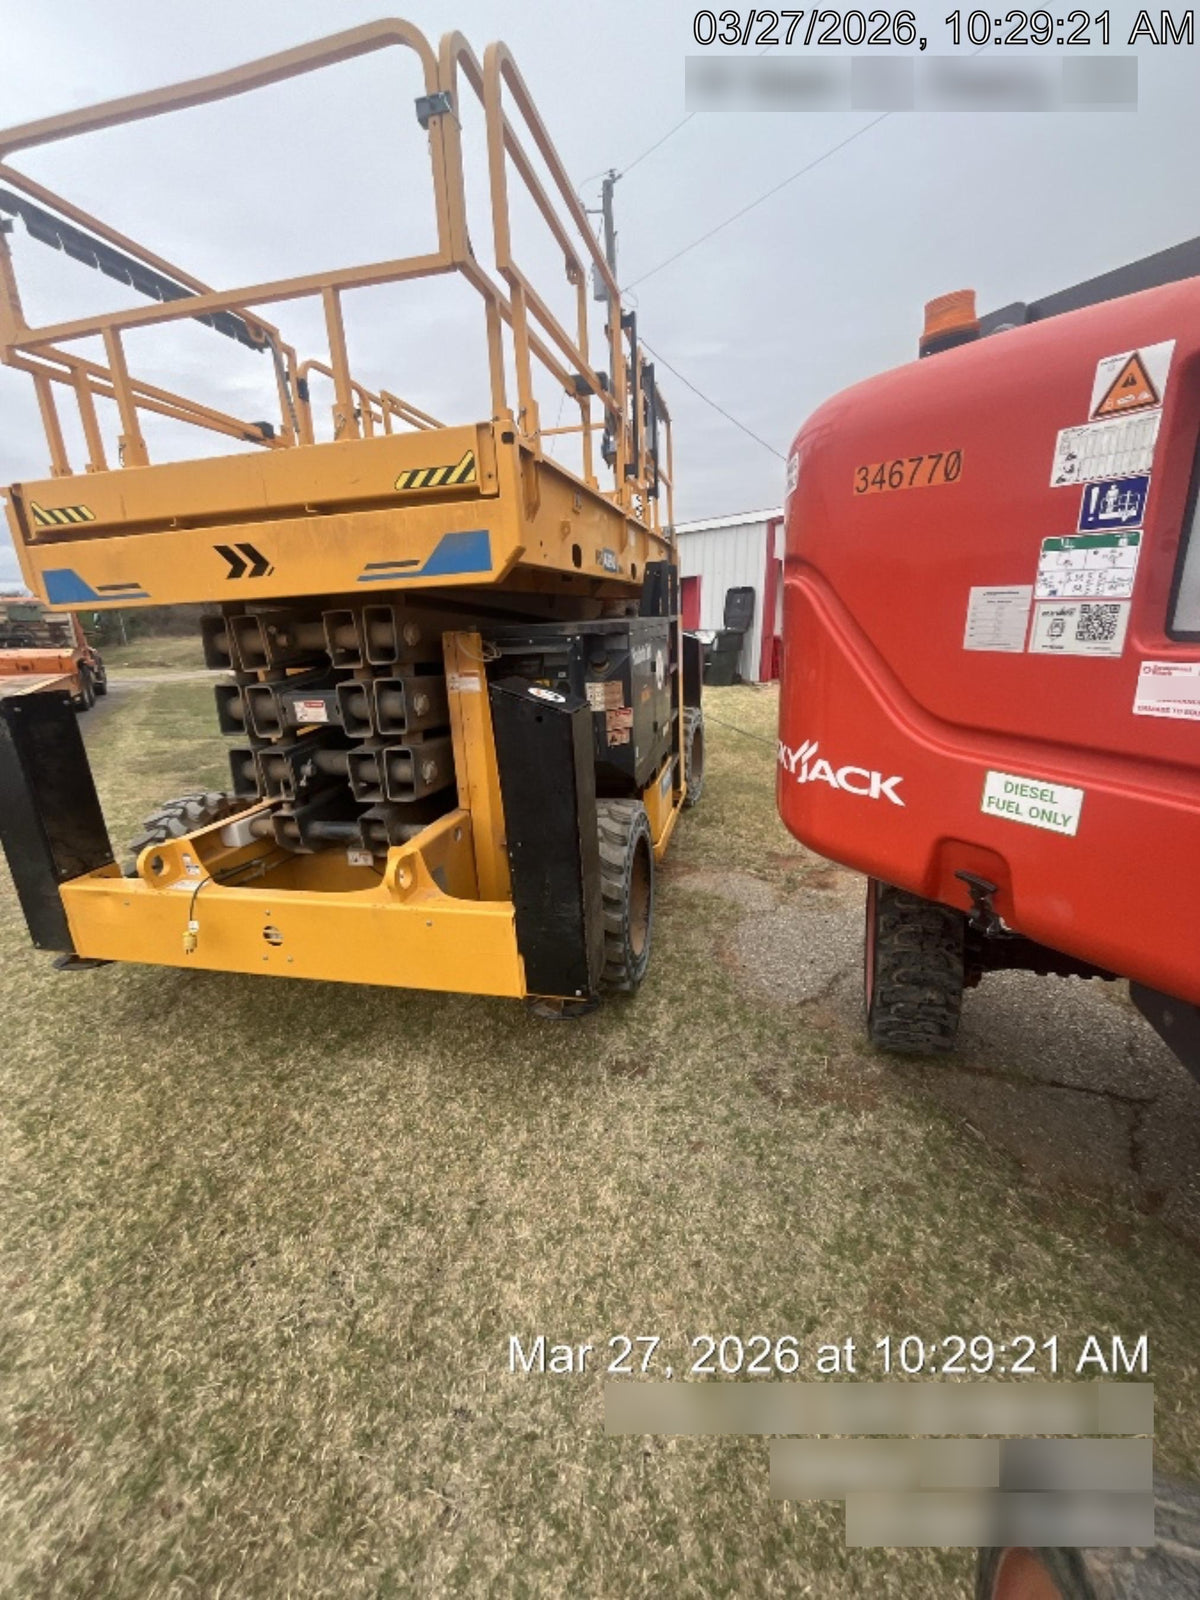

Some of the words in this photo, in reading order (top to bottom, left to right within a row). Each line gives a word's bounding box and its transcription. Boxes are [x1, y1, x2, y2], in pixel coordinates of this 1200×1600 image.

[856, 450, 962, 493] 346770
[1004, 781, 1058, 804] DIESEL
[987, 796, 1022, 816] FUEL
[1028, 806, 1073, 827] ONLY
